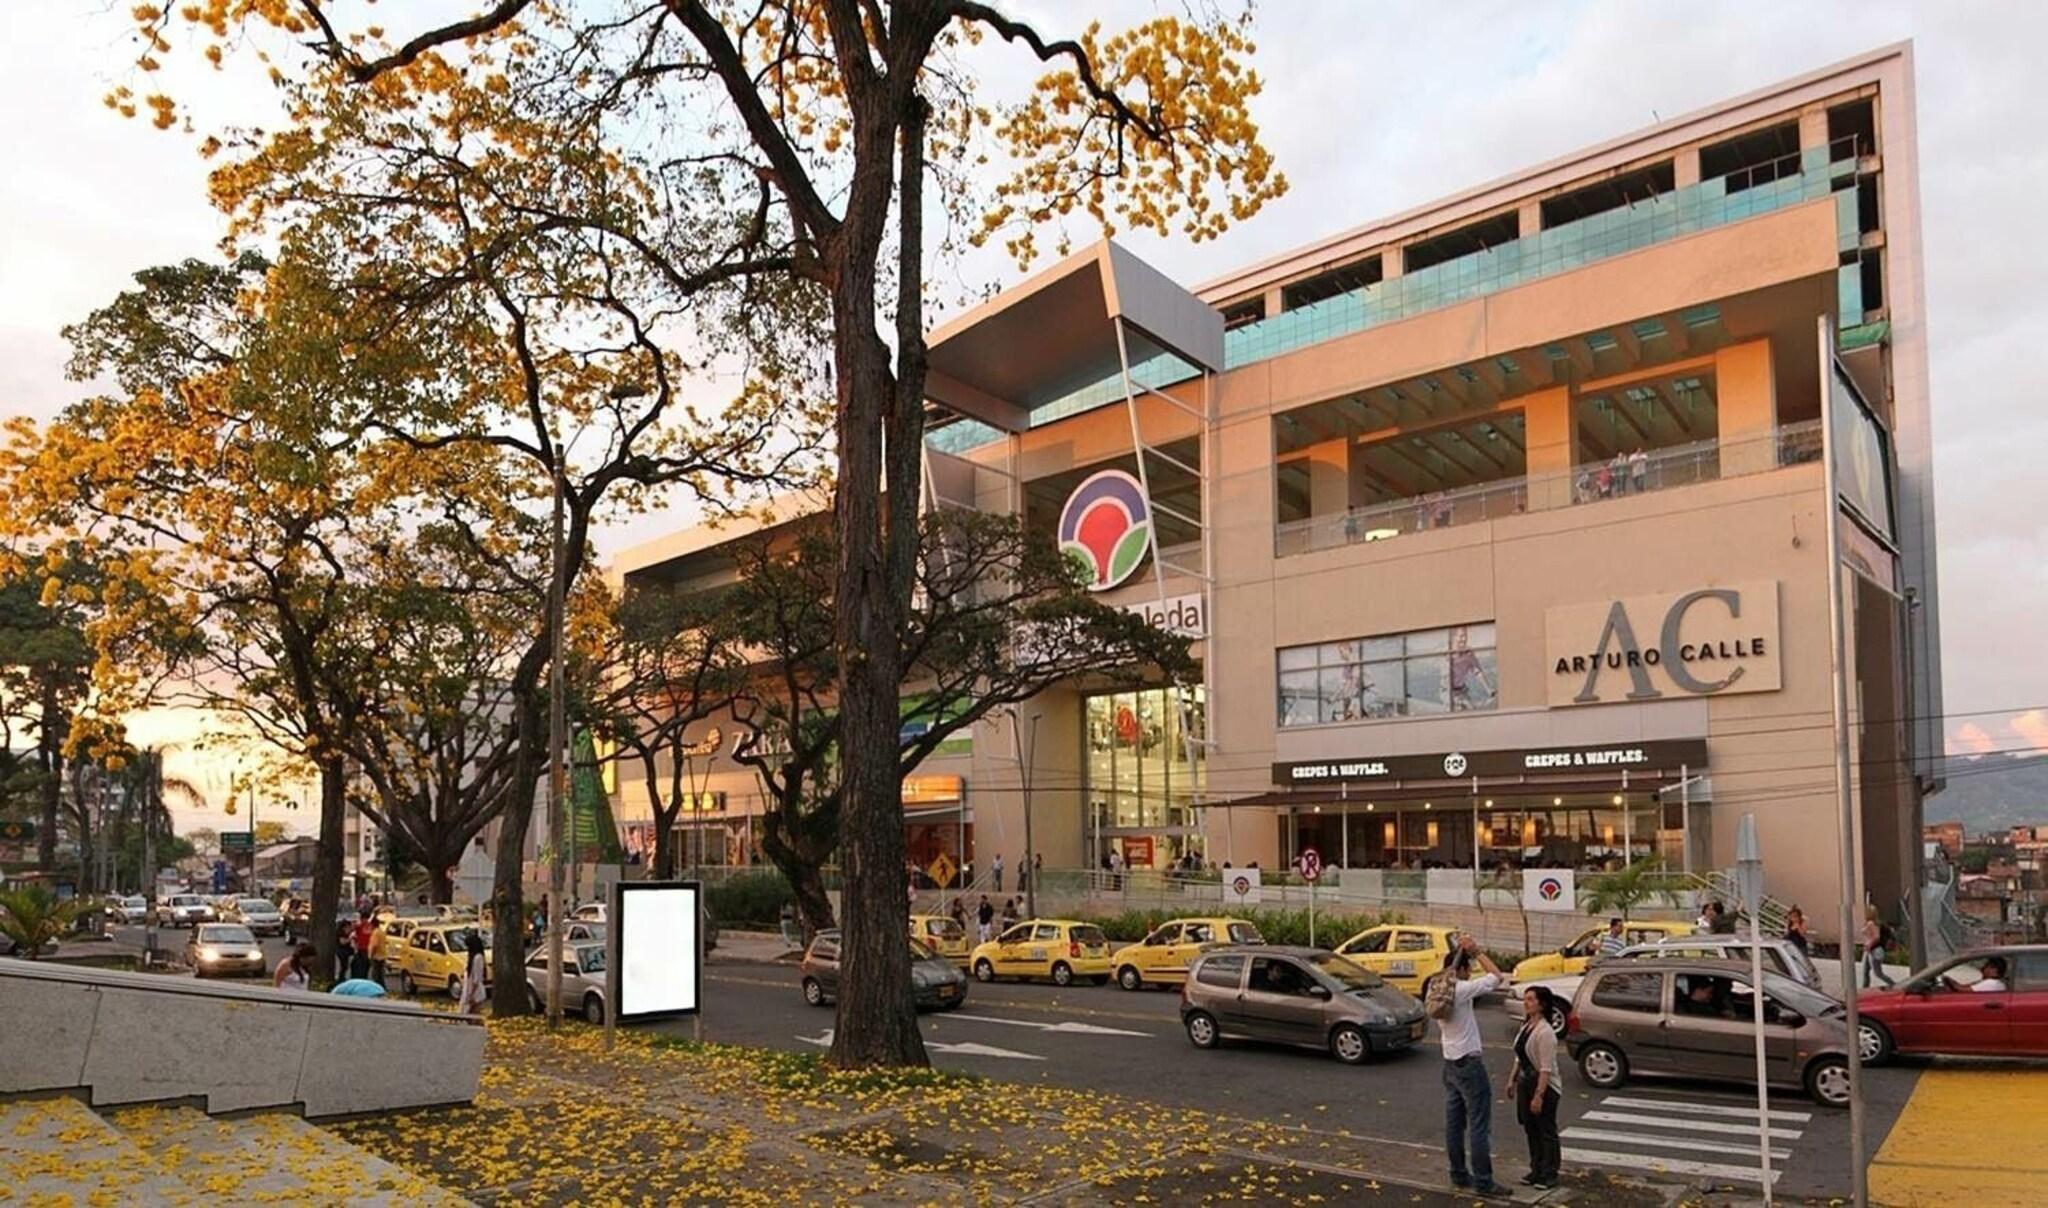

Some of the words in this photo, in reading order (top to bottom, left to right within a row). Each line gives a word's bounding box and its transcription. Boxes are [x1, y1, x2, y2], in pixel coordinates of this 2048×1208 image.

[1554, 647, 1661, 674] ARTURO
[1679, 637, 1766, 663] CALLE
[1525, 753, 1571, 768] CREPES
[1574, 752, 1584, 766] &
[1292, 765, 1329, 779] CREPES
[1330, 764, 1338, 777] &
